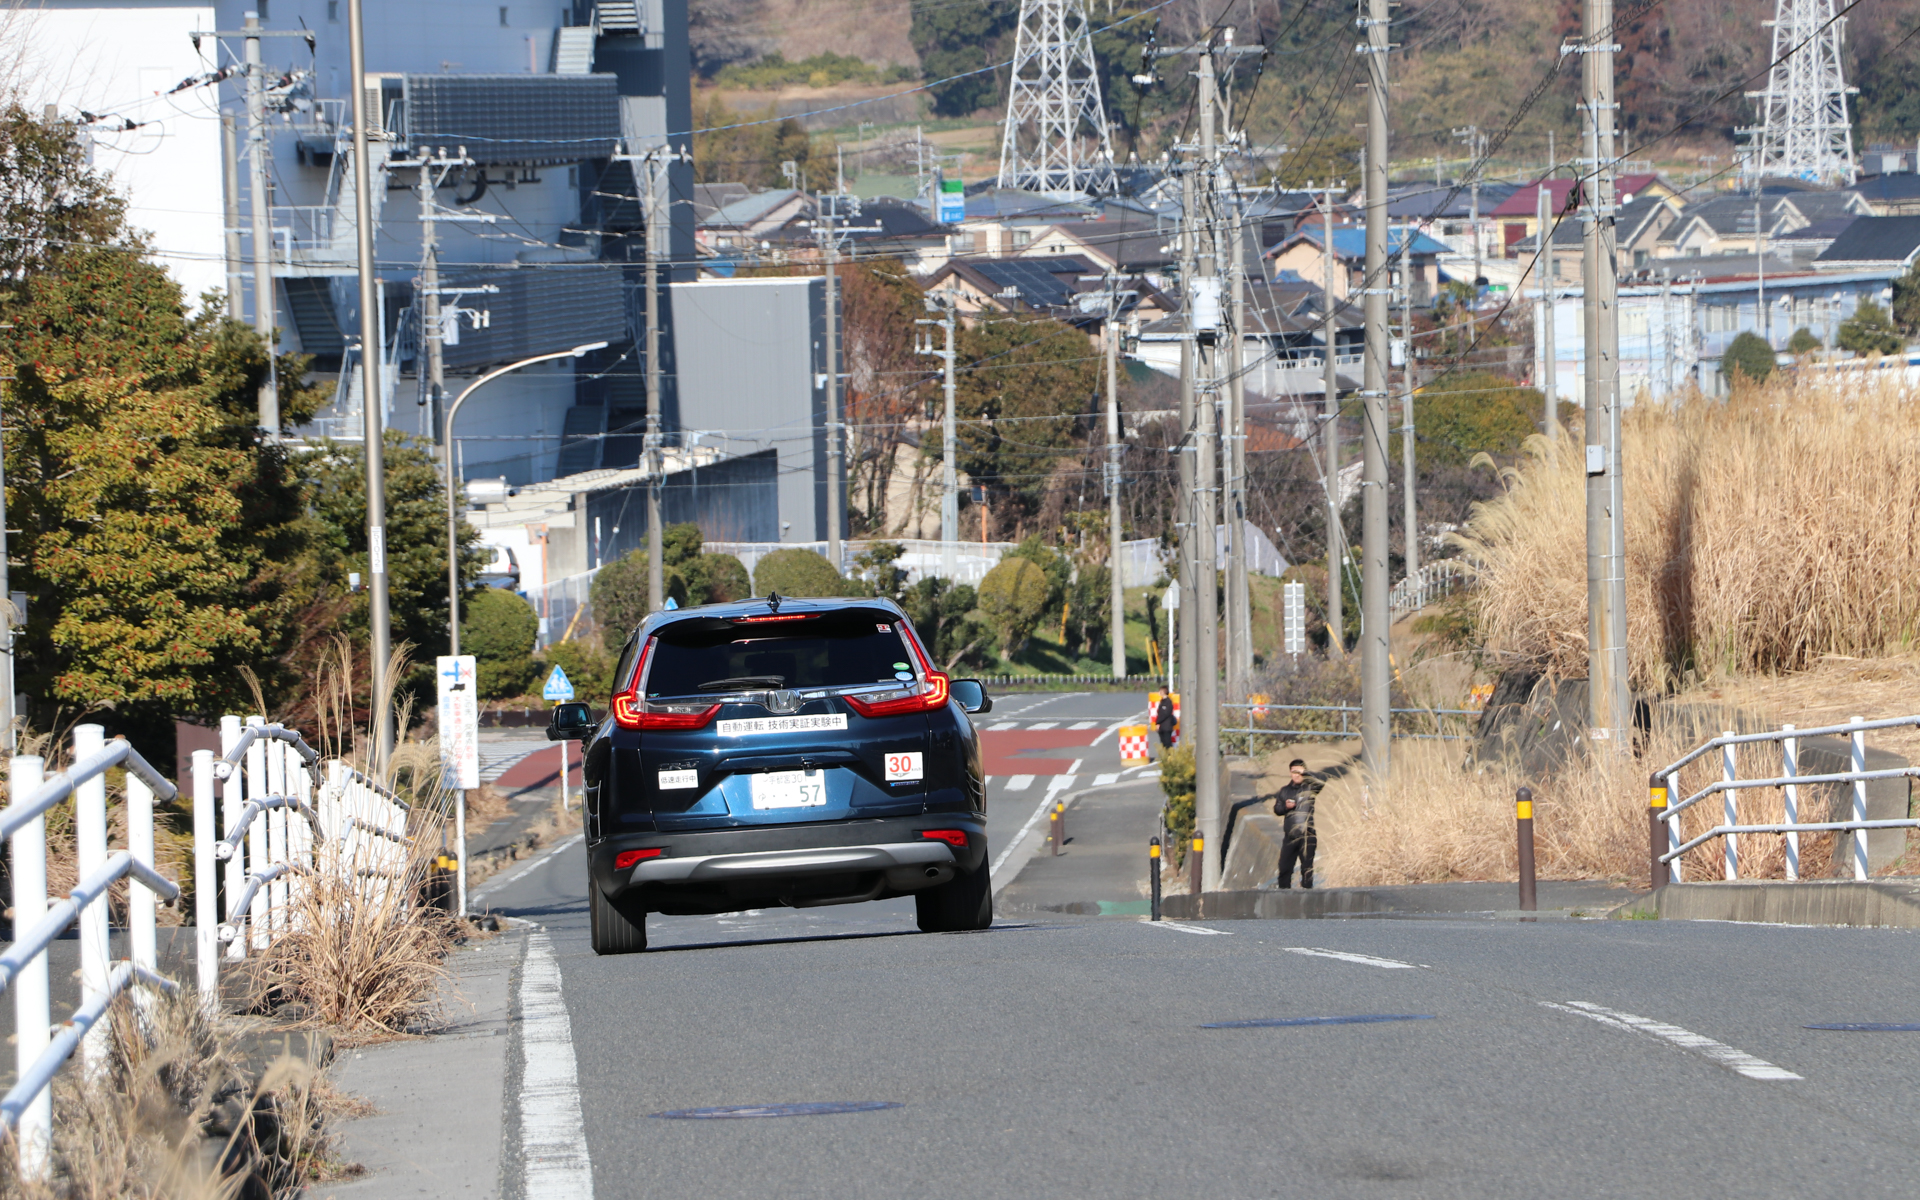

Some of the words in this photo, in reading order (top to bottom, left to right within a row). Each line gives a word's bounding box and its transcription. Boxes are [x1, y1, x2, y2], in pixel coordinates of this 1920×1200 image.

[722, 720, 764, 733] 自動運転
[768, 716, 842, 731] 技術実証実験中
[889, 755, 911, 772] 30
